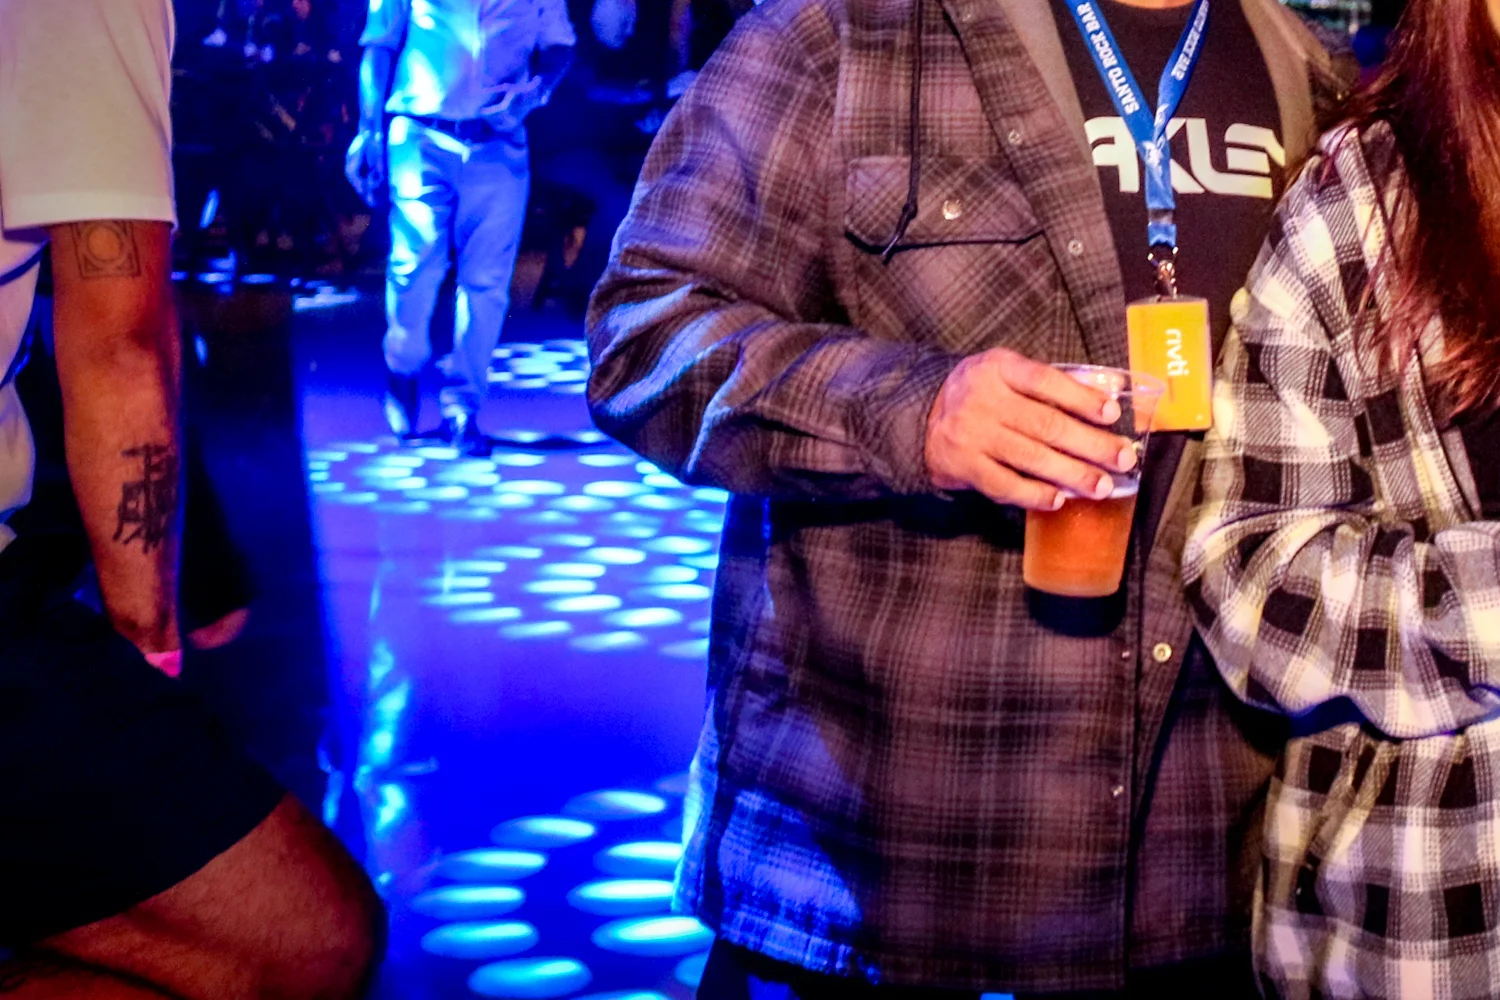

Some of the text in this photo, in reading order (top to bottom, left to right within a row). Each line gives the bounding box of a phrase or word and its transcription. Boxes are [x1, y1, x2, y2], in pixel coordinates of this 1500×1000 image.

[1076, 1, 1141, 116] SANTO ROCK BAR
